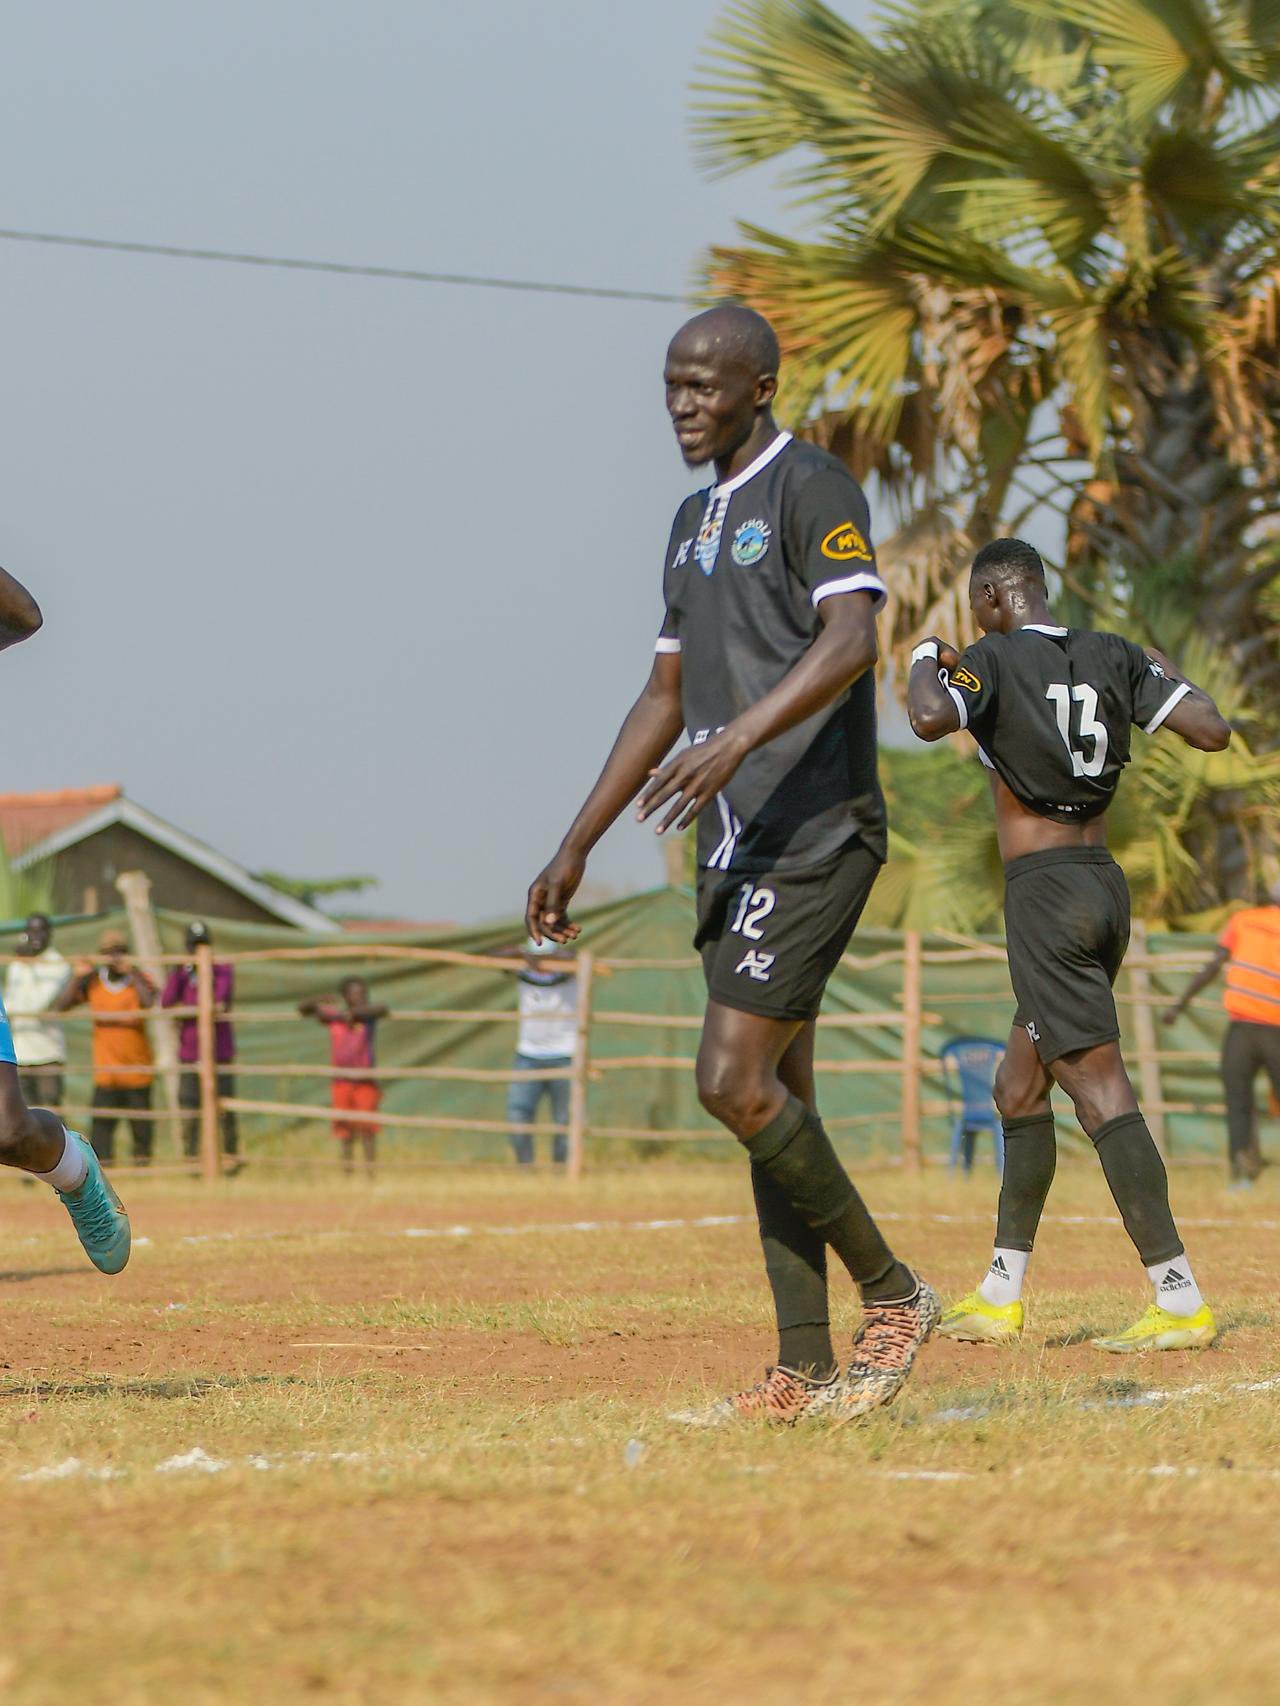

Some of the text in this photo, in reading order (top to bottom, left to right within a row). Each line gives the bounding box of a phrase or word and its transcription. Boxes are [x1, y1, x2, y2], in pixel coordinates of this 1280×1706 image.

[954, 672, 971, 683] TN
[1045, 683, 1108, 777] 13
[731, 882, 775, 941] 12
[1160, 1279, 1191, 1292] adidas
